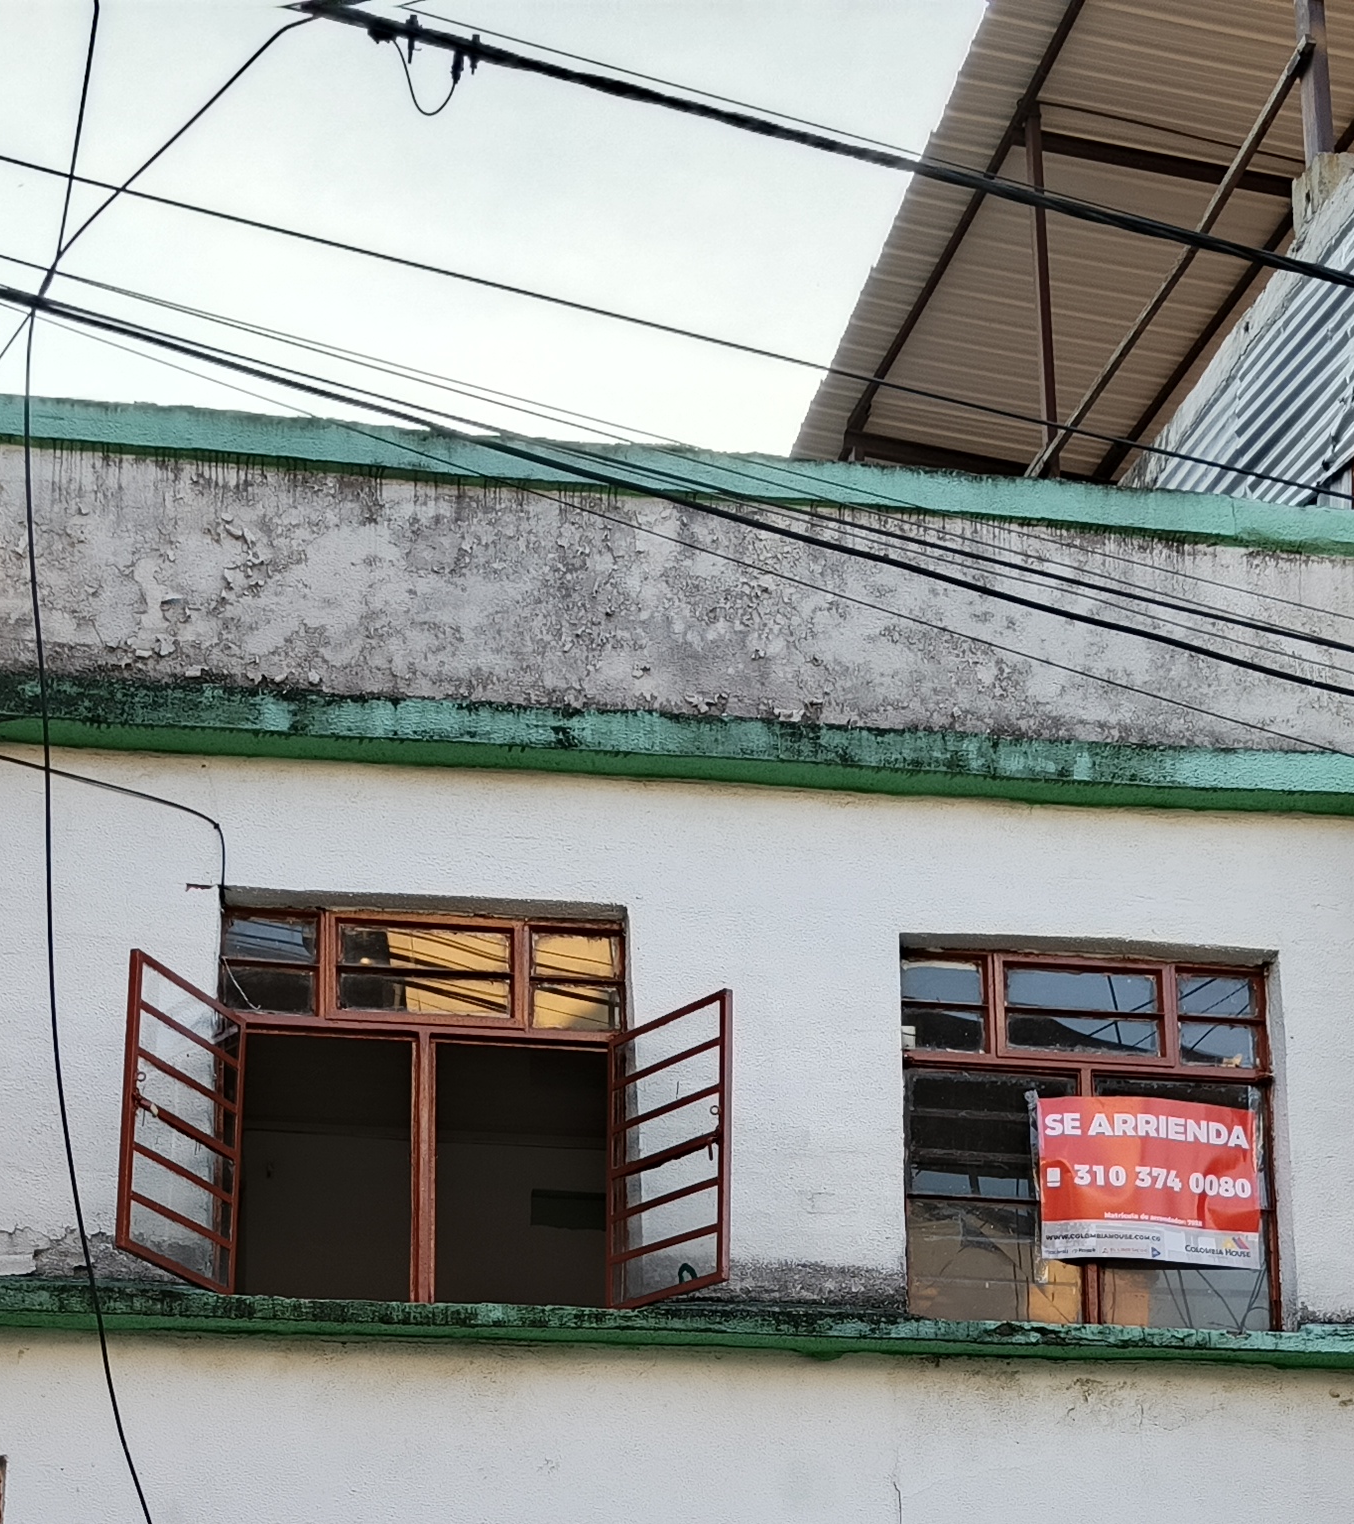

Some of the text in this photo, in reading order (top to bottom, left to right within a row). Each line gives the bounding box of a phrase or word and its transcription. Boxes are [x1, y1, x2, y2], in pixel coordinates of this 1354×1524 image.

[1045, 1113, 1249, 1149] SE ARRIENDA
[1074, 1164, 1251, 1198] 310 374 0080
[1185, 1244, 1251, 1258] COLOMBIA HOUSE
